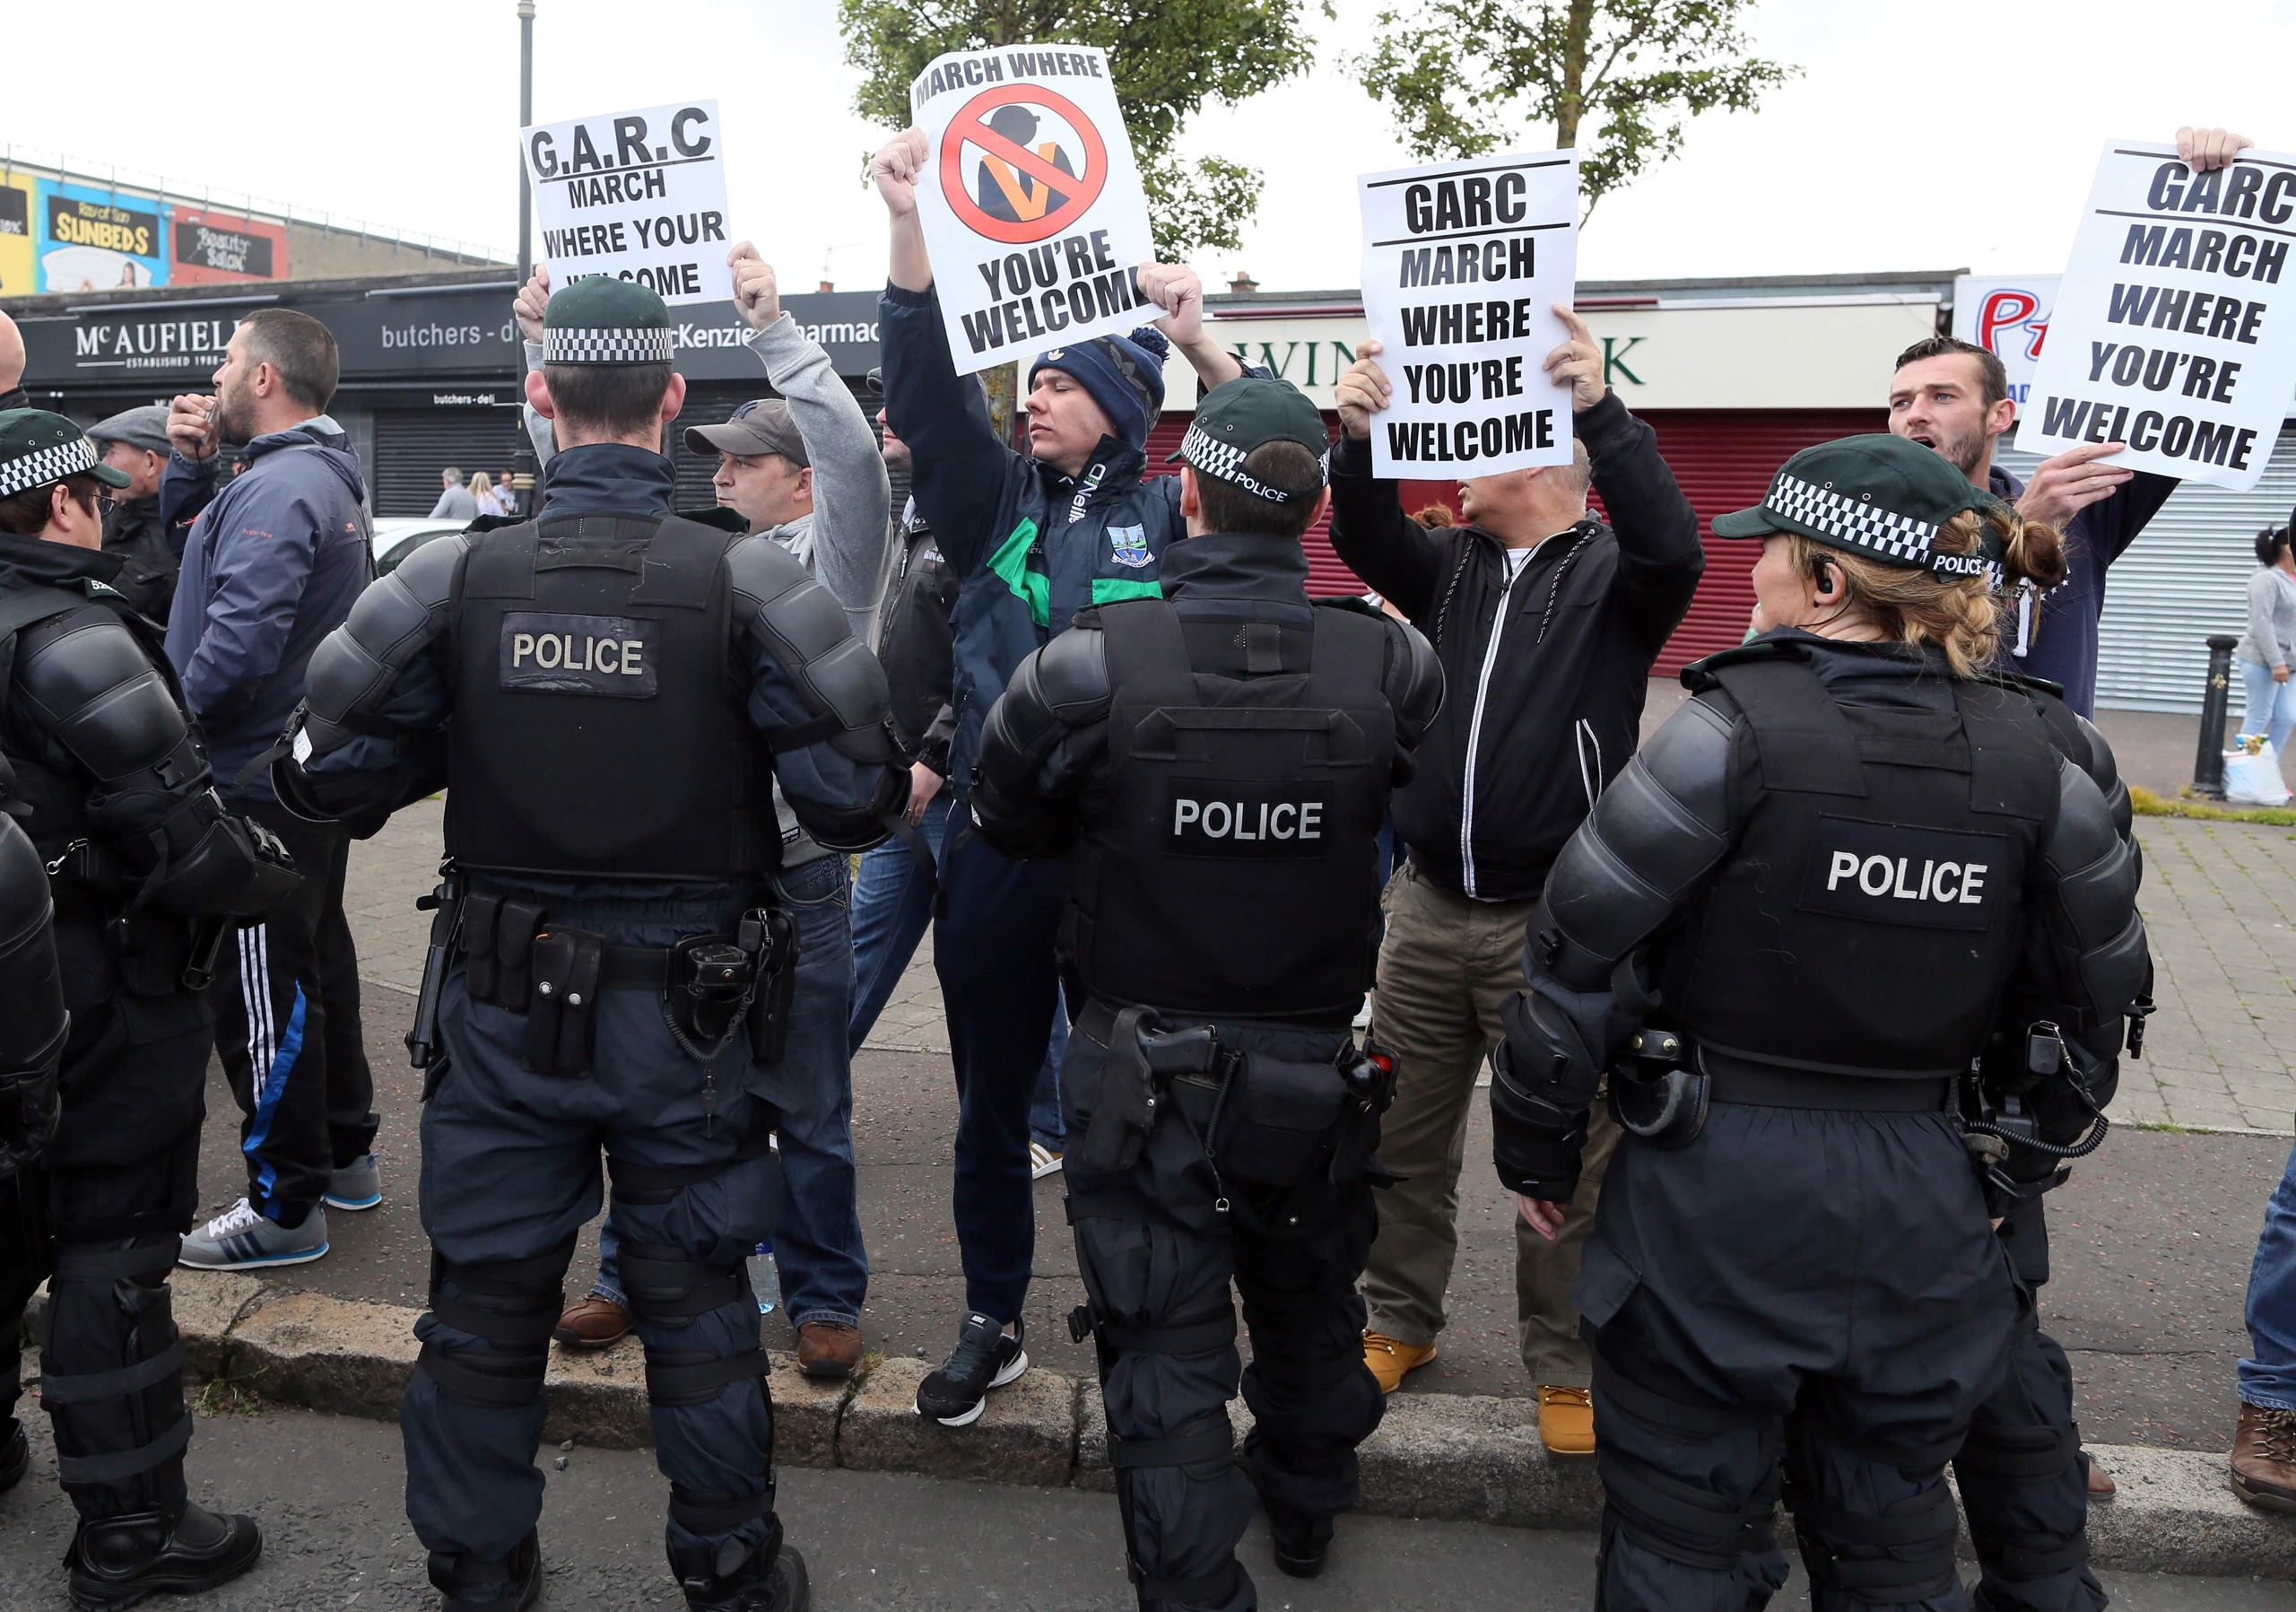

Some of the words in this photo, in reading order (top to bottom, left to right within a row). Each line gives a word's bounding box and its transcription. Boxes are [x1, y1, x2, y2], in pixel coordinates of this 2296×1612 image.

[916, 56, 1004, 110] MARCH
[1006, 52, 1103, 79] WHERE
[531, 107, 711, 178] G.A.R.C
[568, 169, 666, 209] MARCH
[1405, 172, 1526, 234] GARC
[2146, 161, 2296, 224] GARC
[56, 212, 149, 255] SUNBEDS
[544, 222, 628, 258] WHERE
[632, 211, 726, 249] YOUR
[2119, 223, 2290, 284] MARCH
[978, 229, 1116, 302] YOU'RE
[1399, 237, 1535, 288] MARCH
[382, 322, 481, 348] butchers
[671, 321, 753, 349] cKenzie
[1401, 298, 1531, 346] WHERE
[2107, 283, 2267, 344] WHERE
[126, 356, 190, 369] ESTABLISHED
[195, 355, 218, 366] 1988
[1403, 356, 1523, 404] YOU'RE
[2089, 341, 2242, 404] YOU'RE
[1387, 409, 1554, 462] WELCOME
[2041, 396, 2257, 471] WELCOME
[1234, 472, 1288, 502] POLICE
[1933, 555, 1982, 574] POLICE
[513, 633, 643, 675] POLICE
[1174, 798, 1323, 840] POLICE
[1827, 850, 1988, 904] POLICE
